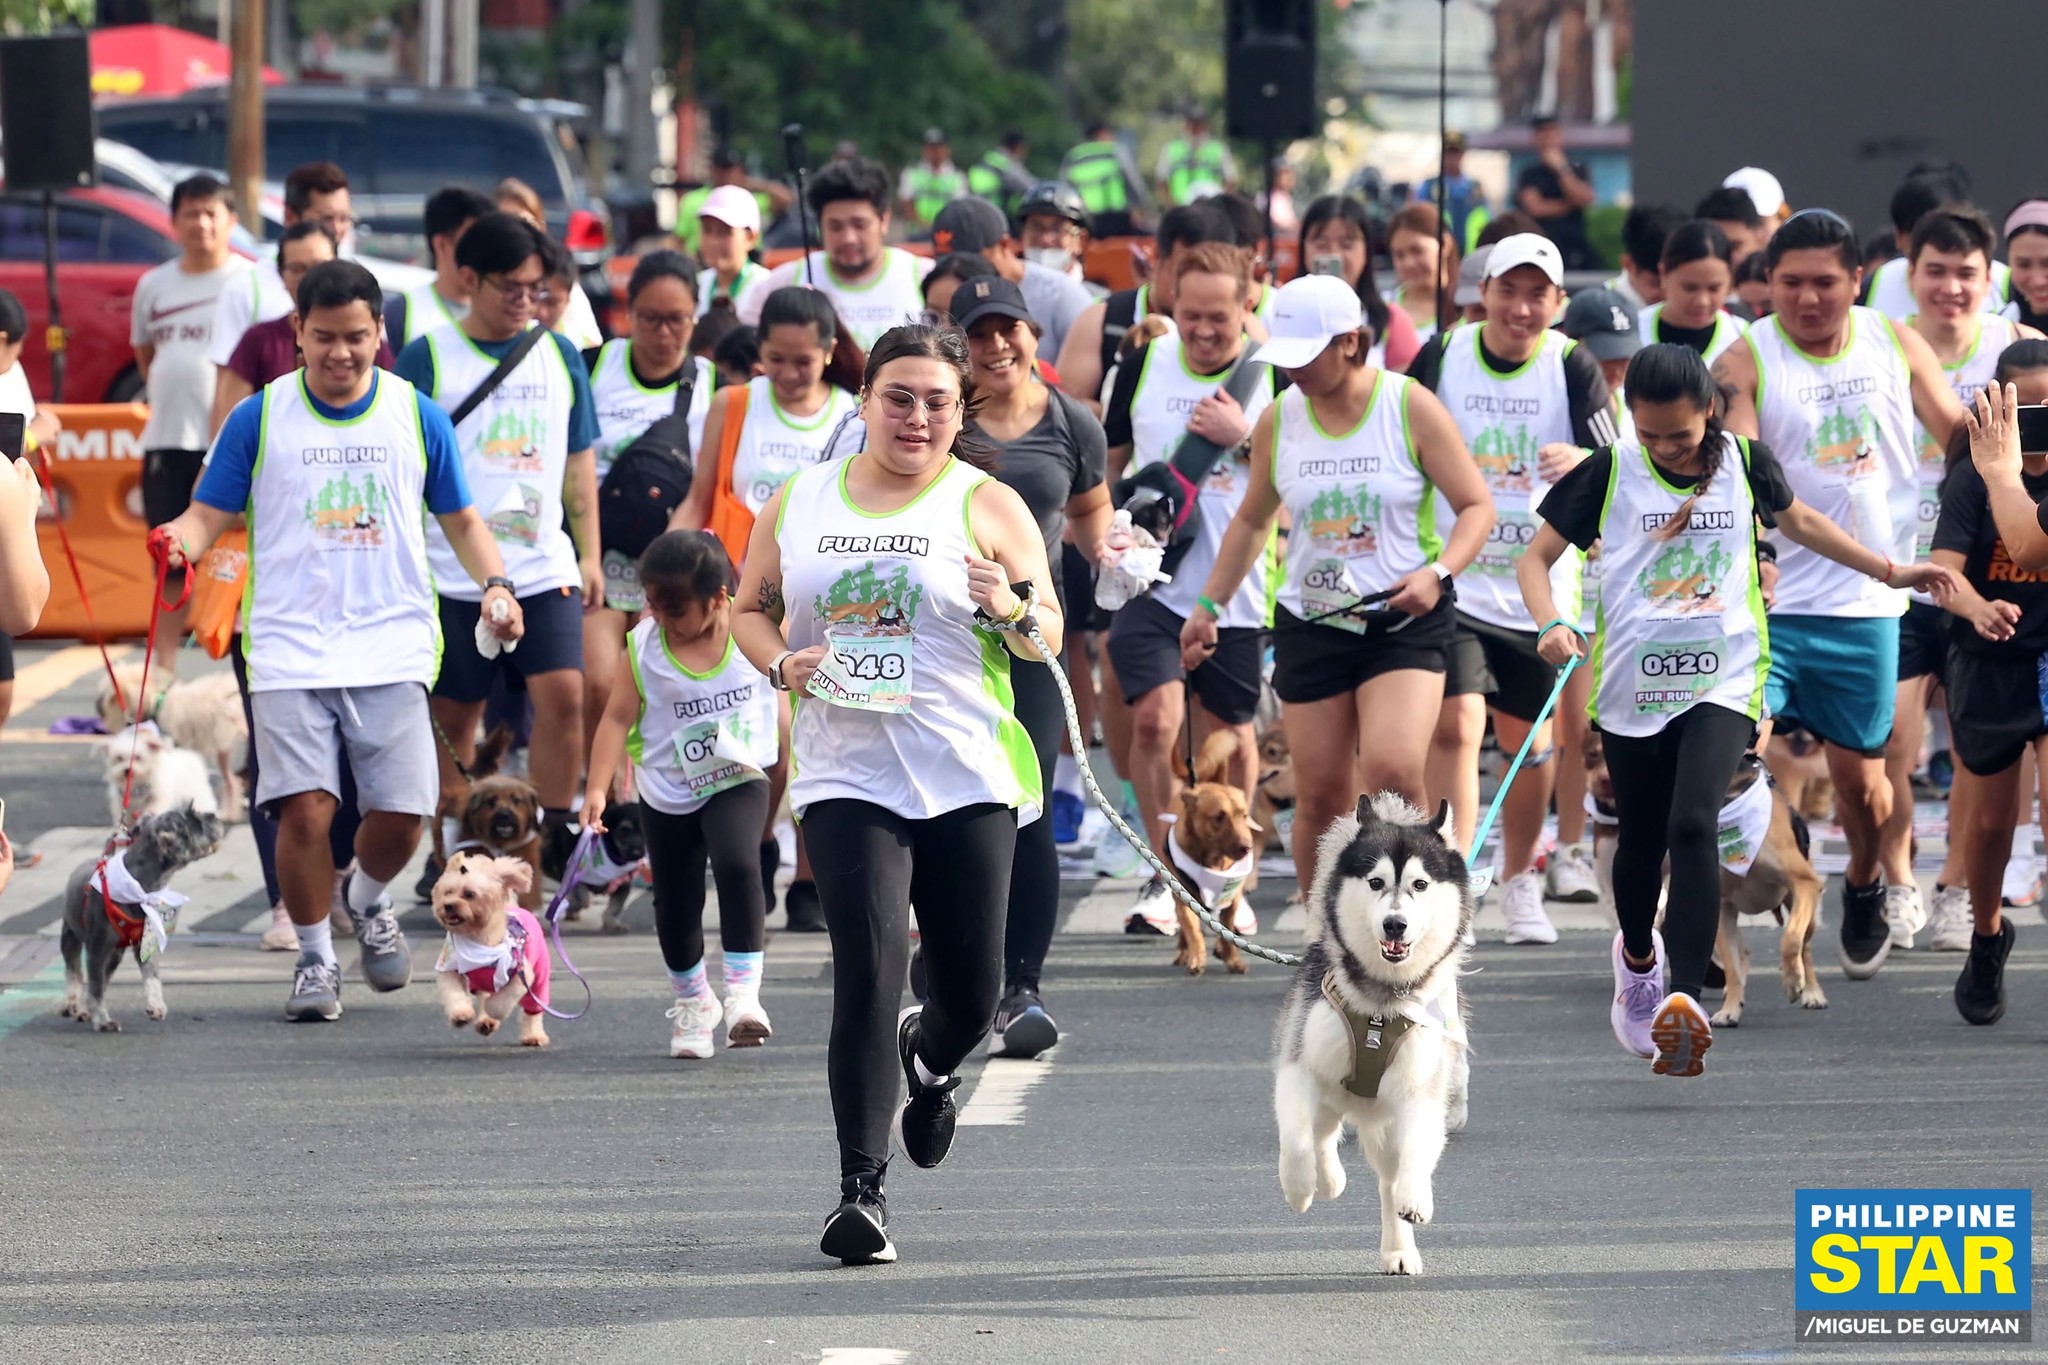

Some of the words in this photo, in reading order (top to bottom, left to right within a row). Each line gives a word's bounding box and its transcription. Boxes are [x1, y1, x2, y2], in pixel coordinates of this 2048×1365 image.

[1502, 399, 1540, 415] RUN
[303, 448, 342, 465] FUR
[345, 446, 387, 463] RUN
[1299, 460, 1337, 477] FUR
[1340, 457, 1380, 474] RUN
[1690, 511, 1734, 530] RUN
[818, 536, 870, 553] FUR
[874, 535, 929, 556] RUN
[1642, 652, 1718, 676] 0120
[812, 668, 838, 695] FUR
[838, 687, 871, 703] RUN
[1636, 692, 1664, 704] FUR
[1666, 690, 1694, 702] RUN
[674, 698, 712, 719] FUR
[688, 774, 714, 791] FUR
[716, 764, 742, 781] RUN
